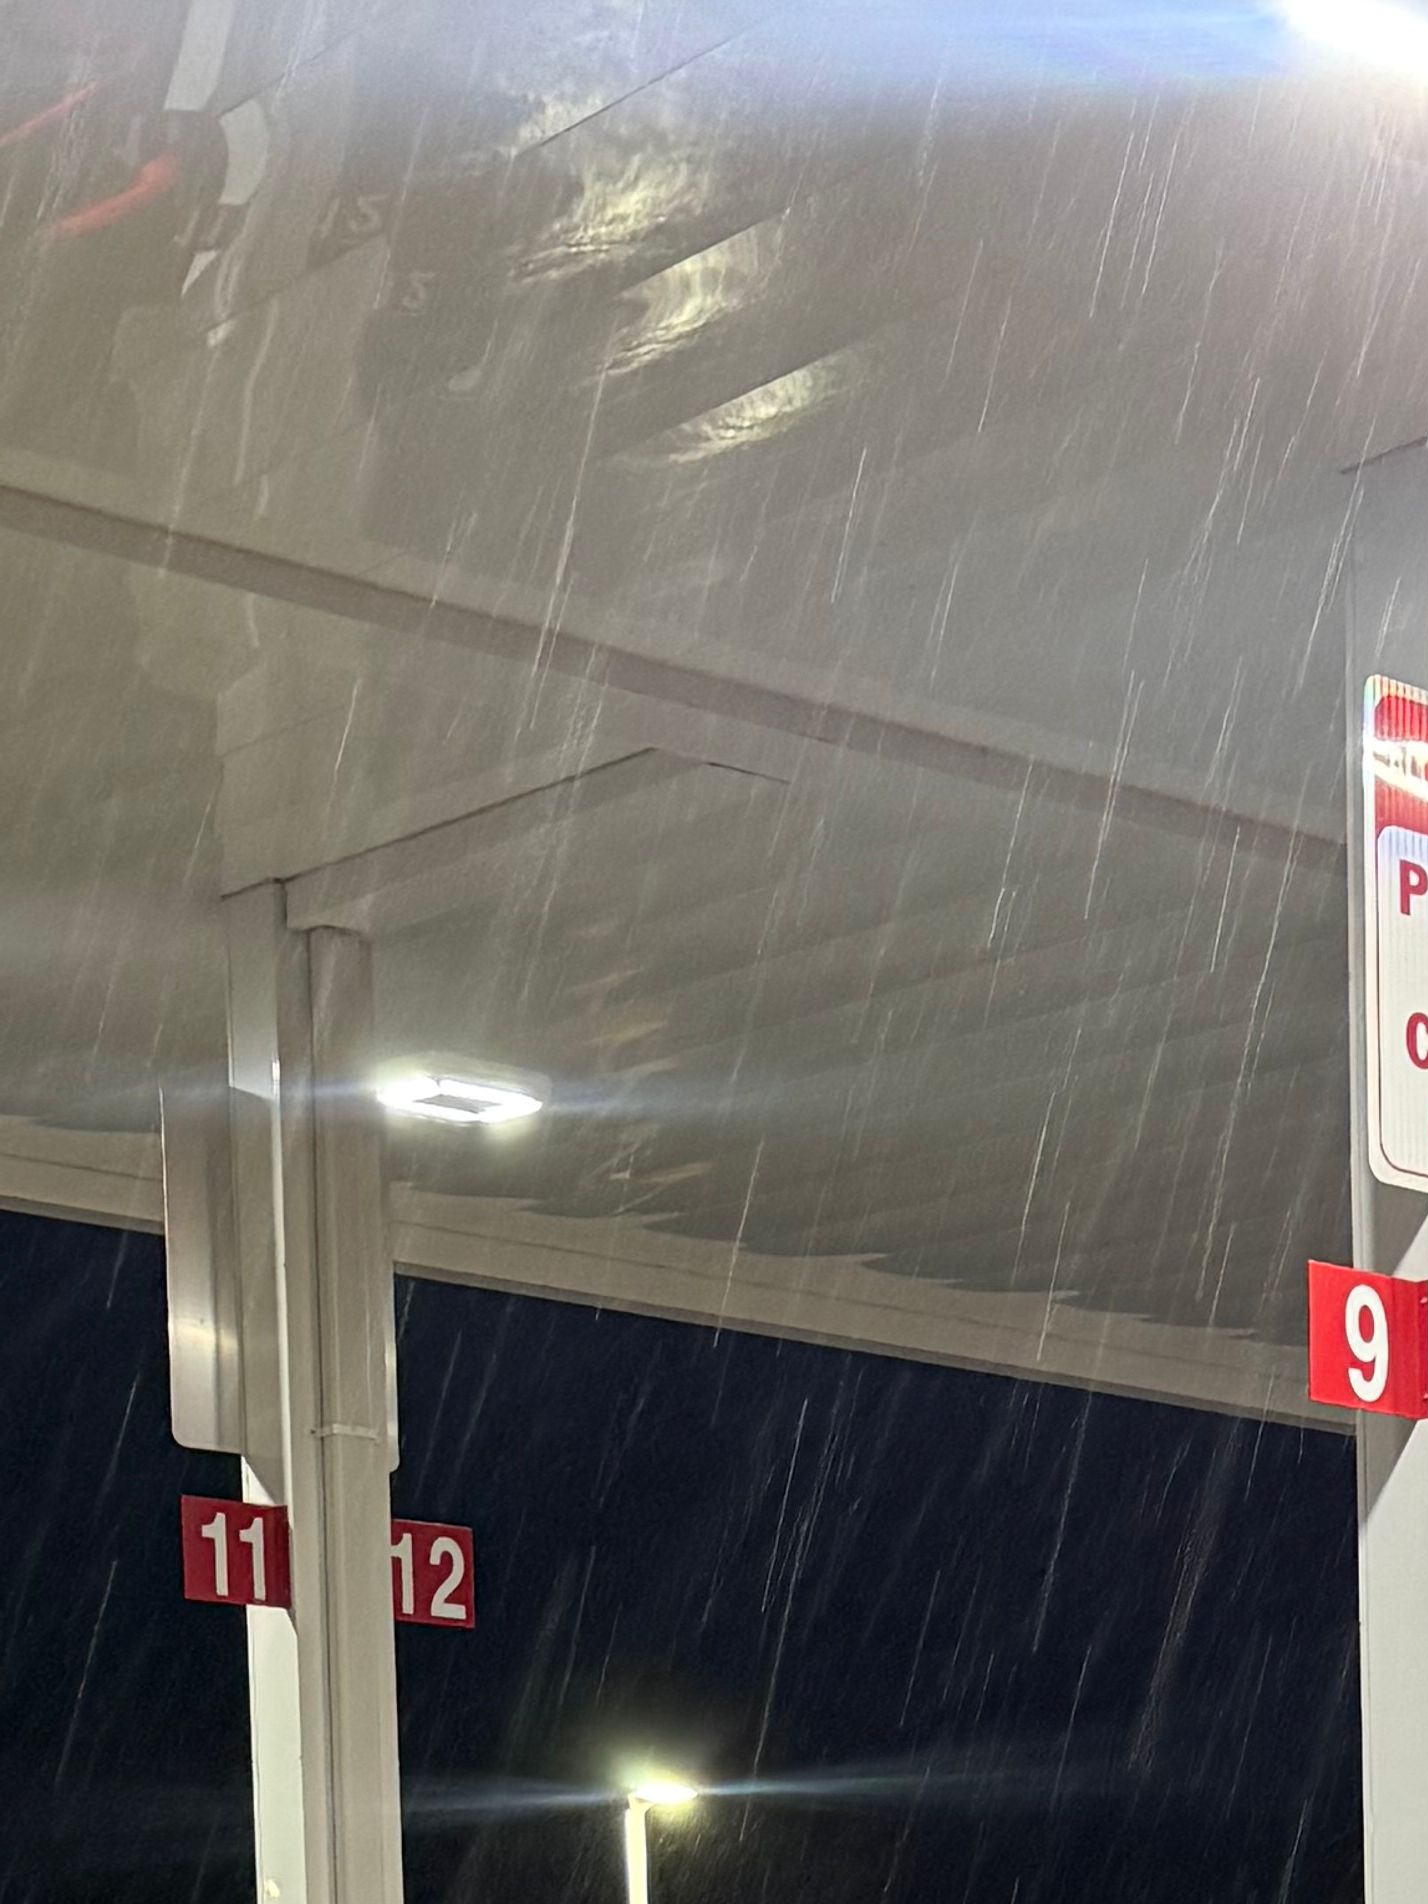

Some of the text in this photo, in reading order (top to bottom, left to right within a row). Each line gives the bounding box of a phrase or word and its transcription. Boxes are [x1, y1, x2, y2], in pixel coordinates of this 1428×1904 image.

[1345, 1284, 1389, 1402] 9
[201, 1512, 266, 1601] 11
[391, 1533, 467, 1620] 12
